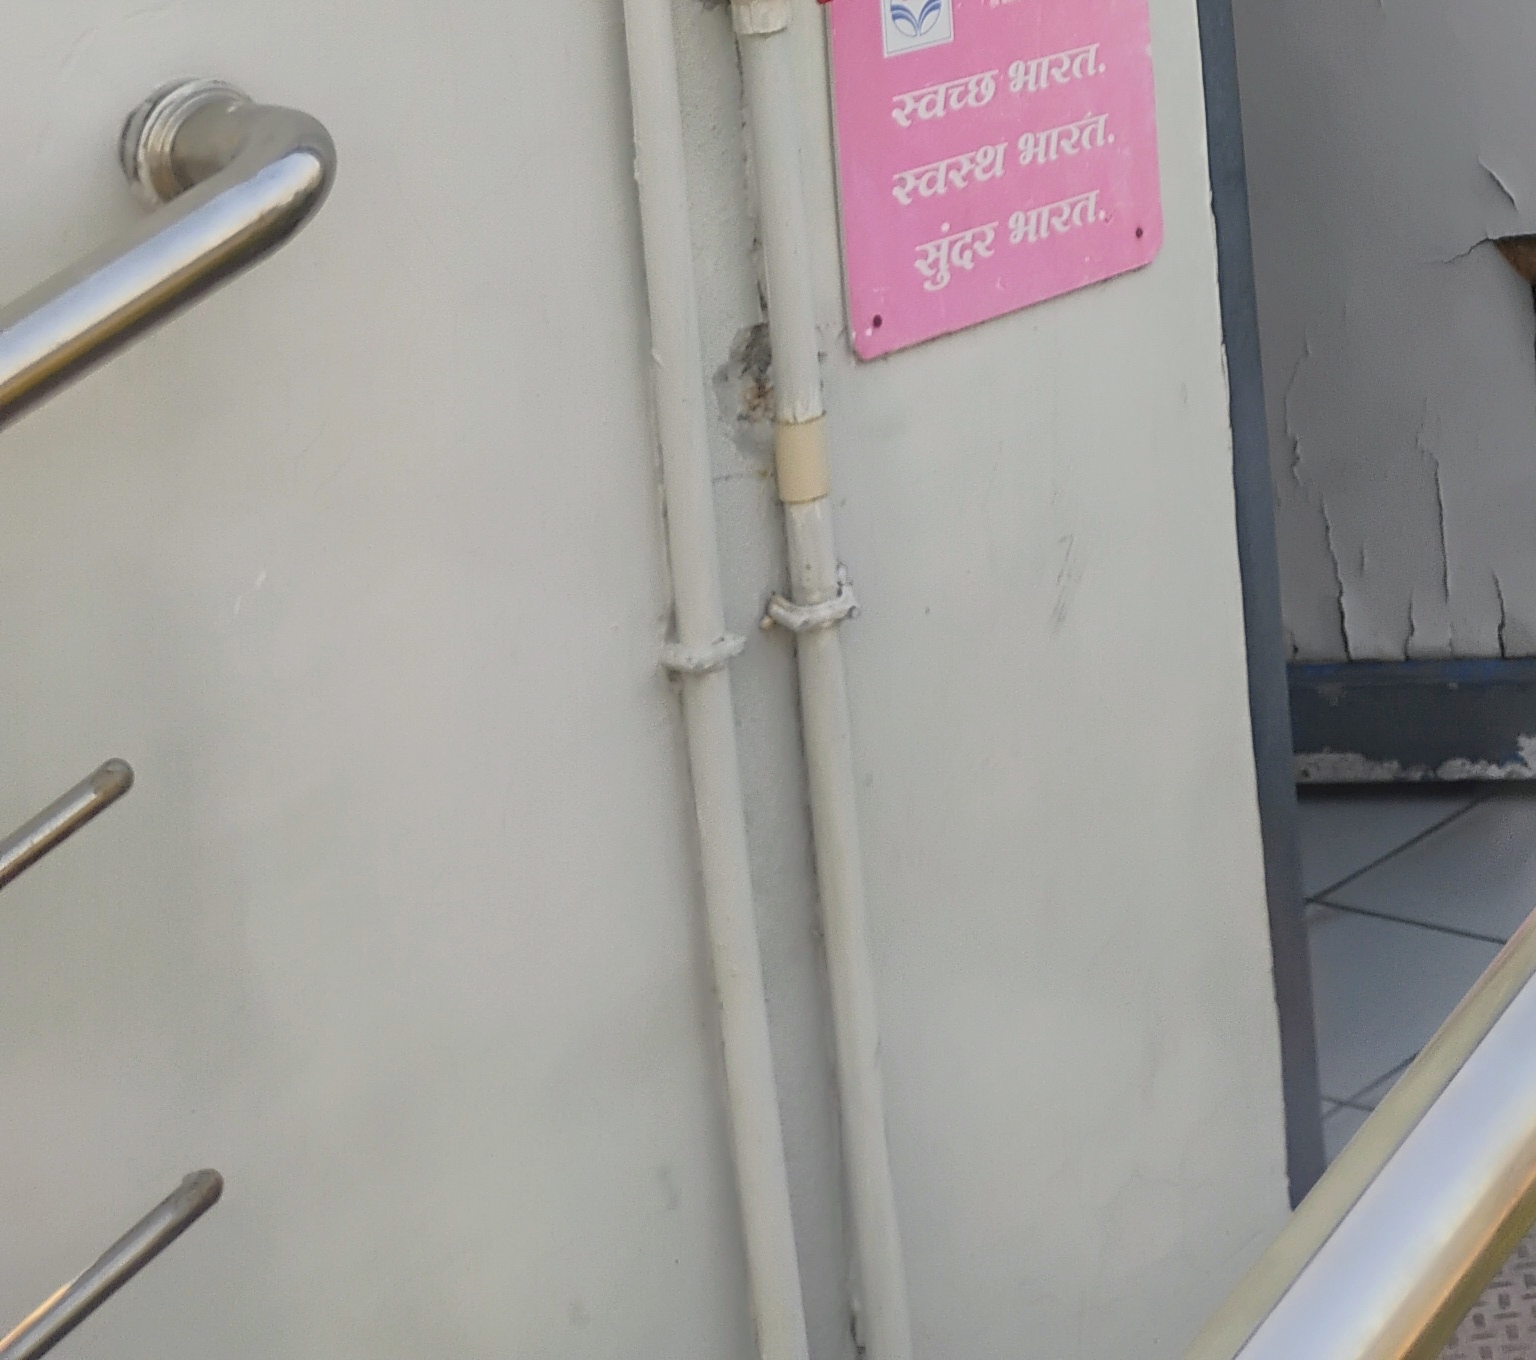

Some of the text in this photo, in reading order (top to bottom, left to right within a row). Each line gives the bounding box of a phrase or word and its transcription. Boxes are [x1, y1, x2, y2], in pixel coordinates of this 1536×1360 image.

[892, 42, 1106, 128] स्वच्छ भारत.
[892, 113, 1115, 206] स्वस्थ भारत.
[914, 189, 1107, 292] सुंदर भारत.
